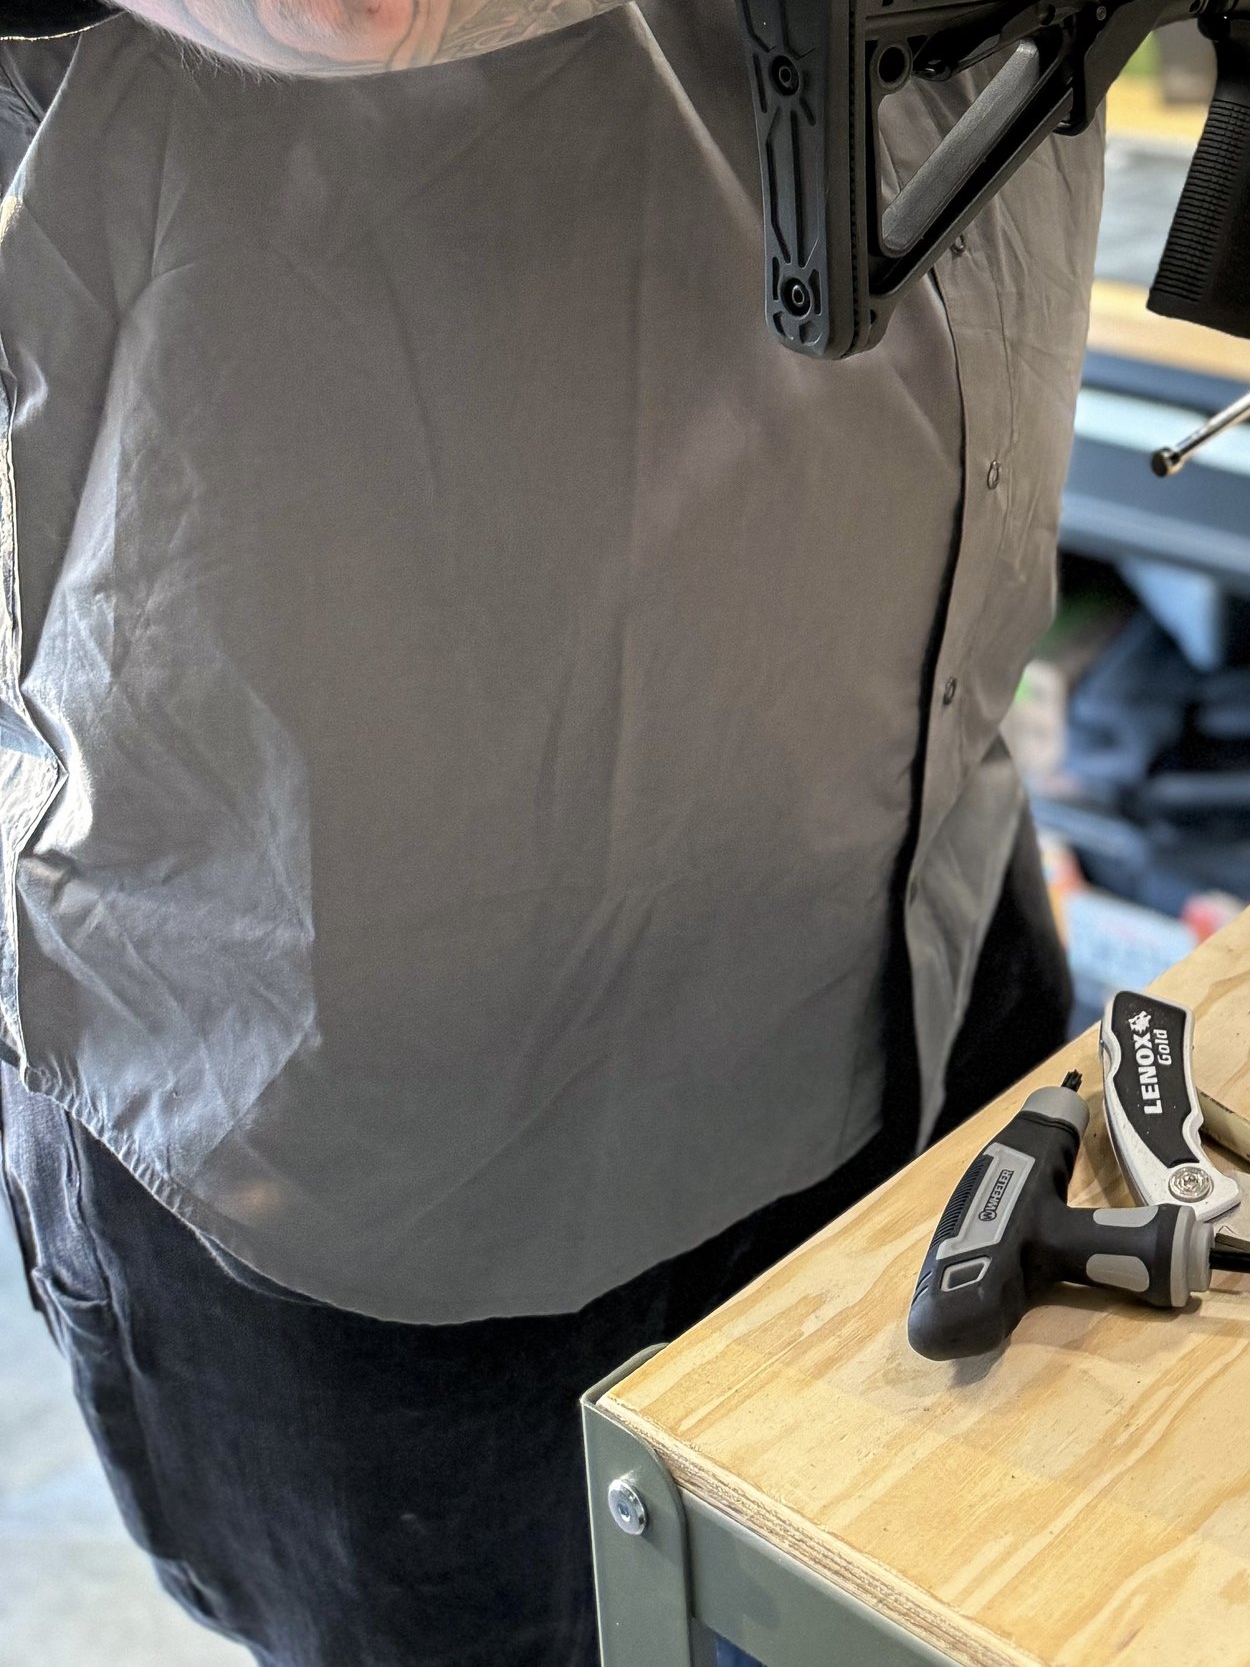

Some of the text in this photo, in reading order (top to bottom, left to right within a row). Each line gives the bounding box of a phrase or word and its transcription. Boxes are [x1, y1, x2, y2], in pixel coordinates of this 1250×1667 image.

[1152, 1028, 1173, 1066] Gold
[1132, 1031, 1164, 1115] LENOX
[984, 1168, 1014, 1213] WHEELER
